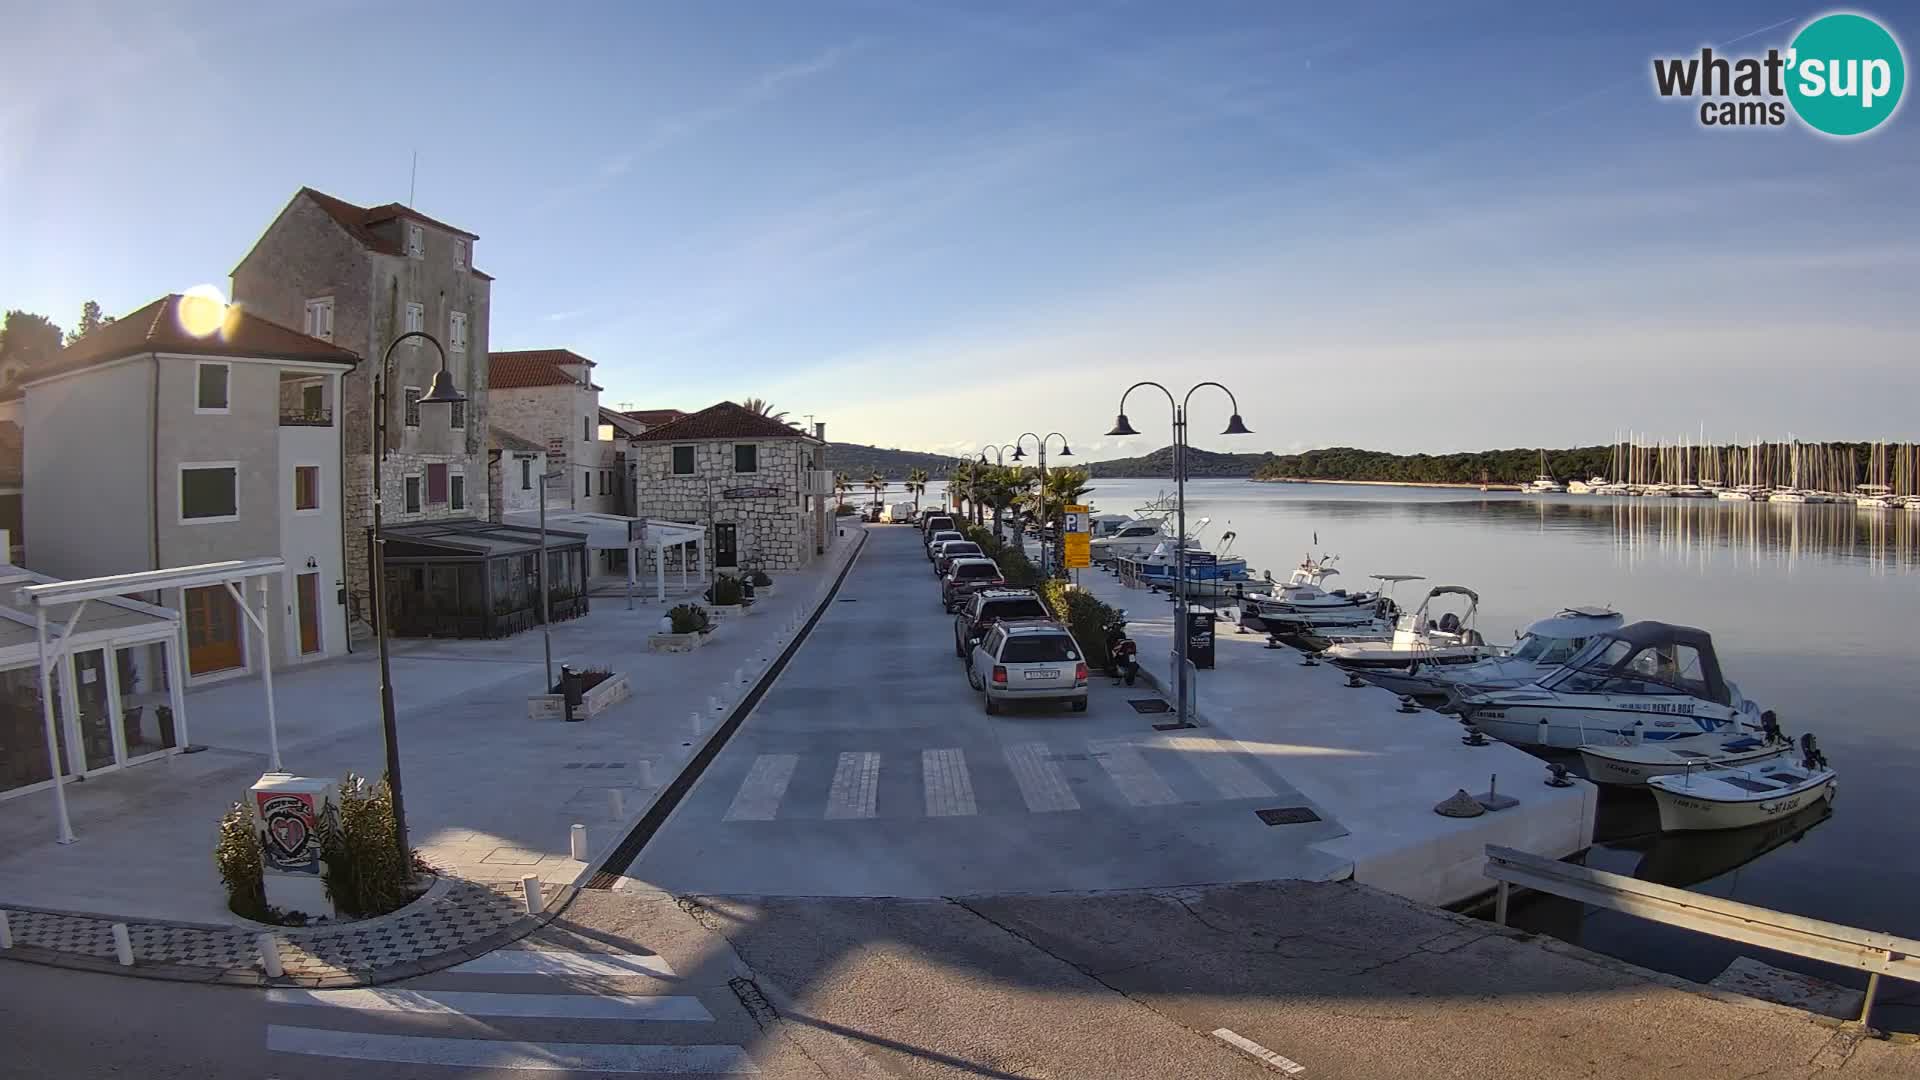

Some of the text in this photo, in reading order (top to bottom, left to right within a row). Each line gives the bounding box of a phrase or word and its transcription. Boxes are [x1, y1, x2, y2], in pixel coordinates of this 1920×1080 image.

[1066, 514, 1076, 531] P
[1652, 703, 1671, 713] RENT
[1677, 703, 1695, 714] BOAT
